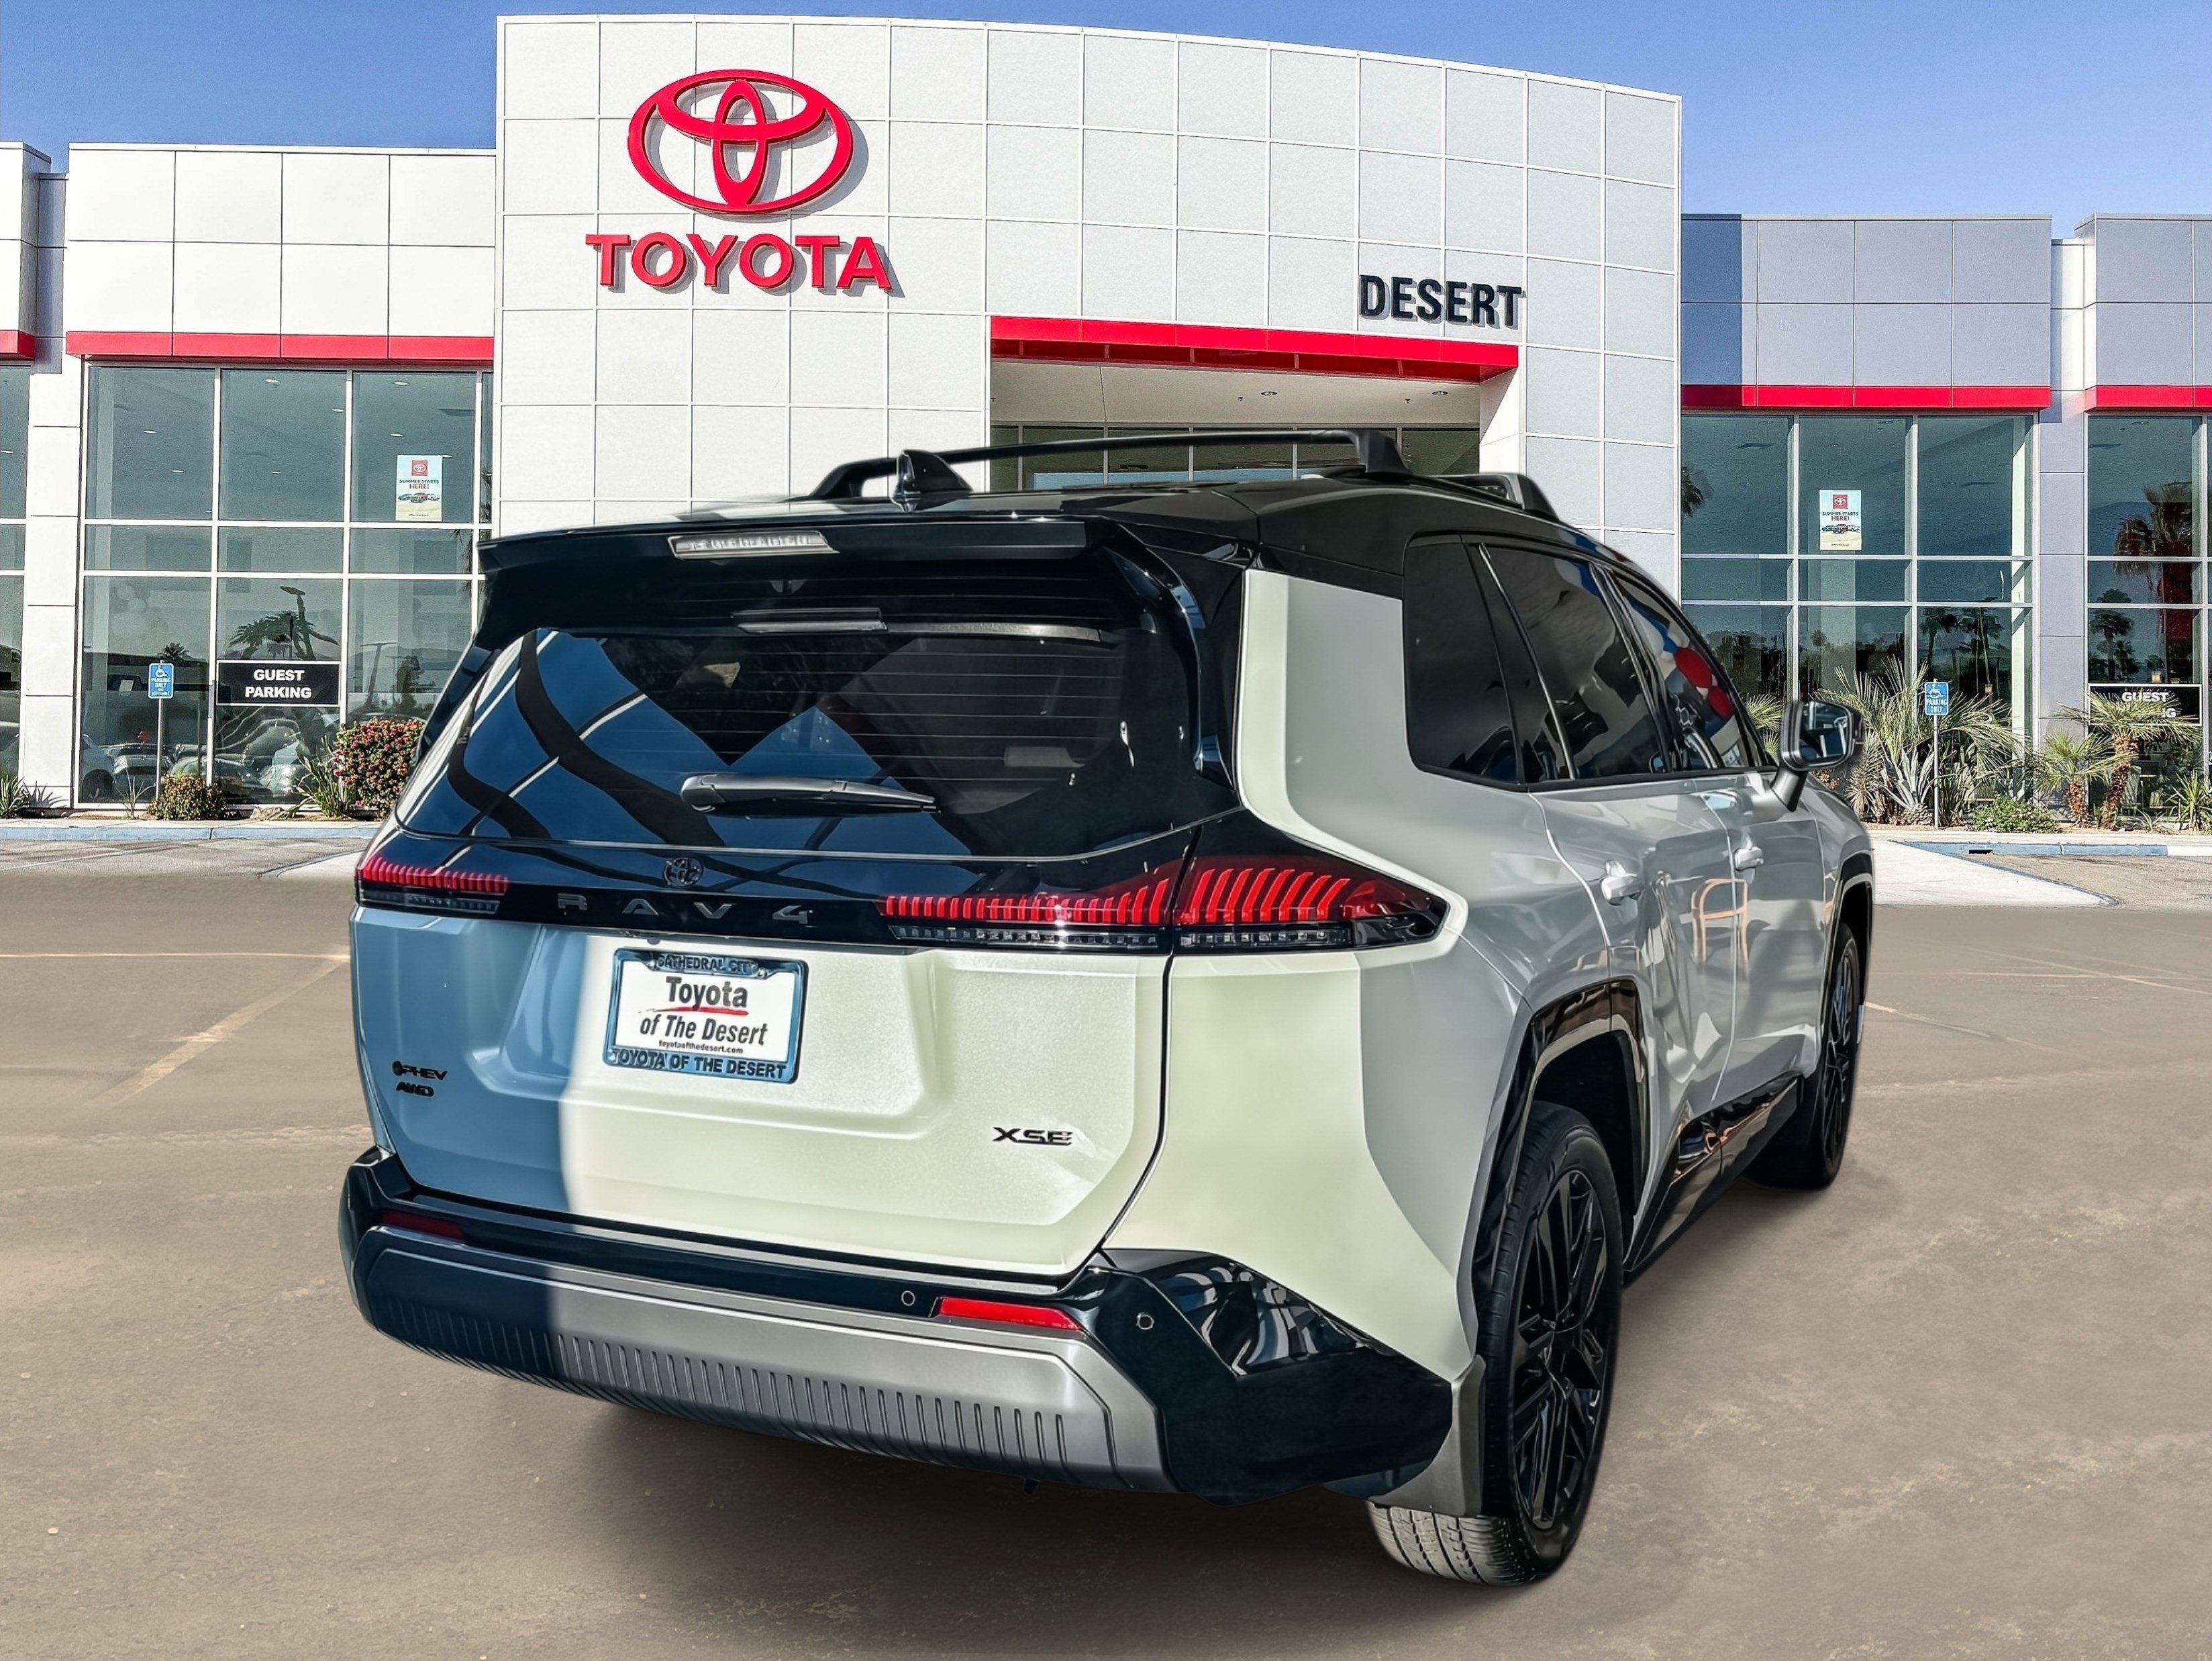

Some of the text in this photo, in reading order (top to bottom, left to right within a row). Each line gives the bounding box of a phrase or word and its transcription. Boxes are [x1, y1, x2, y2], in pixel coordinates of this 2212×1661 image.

[585, 232, 893, 292] TOYOTA
[1359, 274, 1522, 326] DESERT
[253, 669, 305, 681] GUEST
[245, 687, 312, 699] PARKING
[2121, 691, 2169, 703] GUEST
[1930, 705, 1944, 713] ONLY
[557, 893, 809, 925] RAV4
[658, 954, 723, 971] CATHEDRAL
[666, 976, 748, 1011] Toyota
[640, 1014, 768, 1045] of The Desert
[658, 1040, 744, 1054] toyotaofthedesert.com
[611, 1048, 787, 1079] TOYOTA OF THE DESERT
[395, 1081, 434, 1097] AWD
[993, 1127, 1073, 1146] XSE
